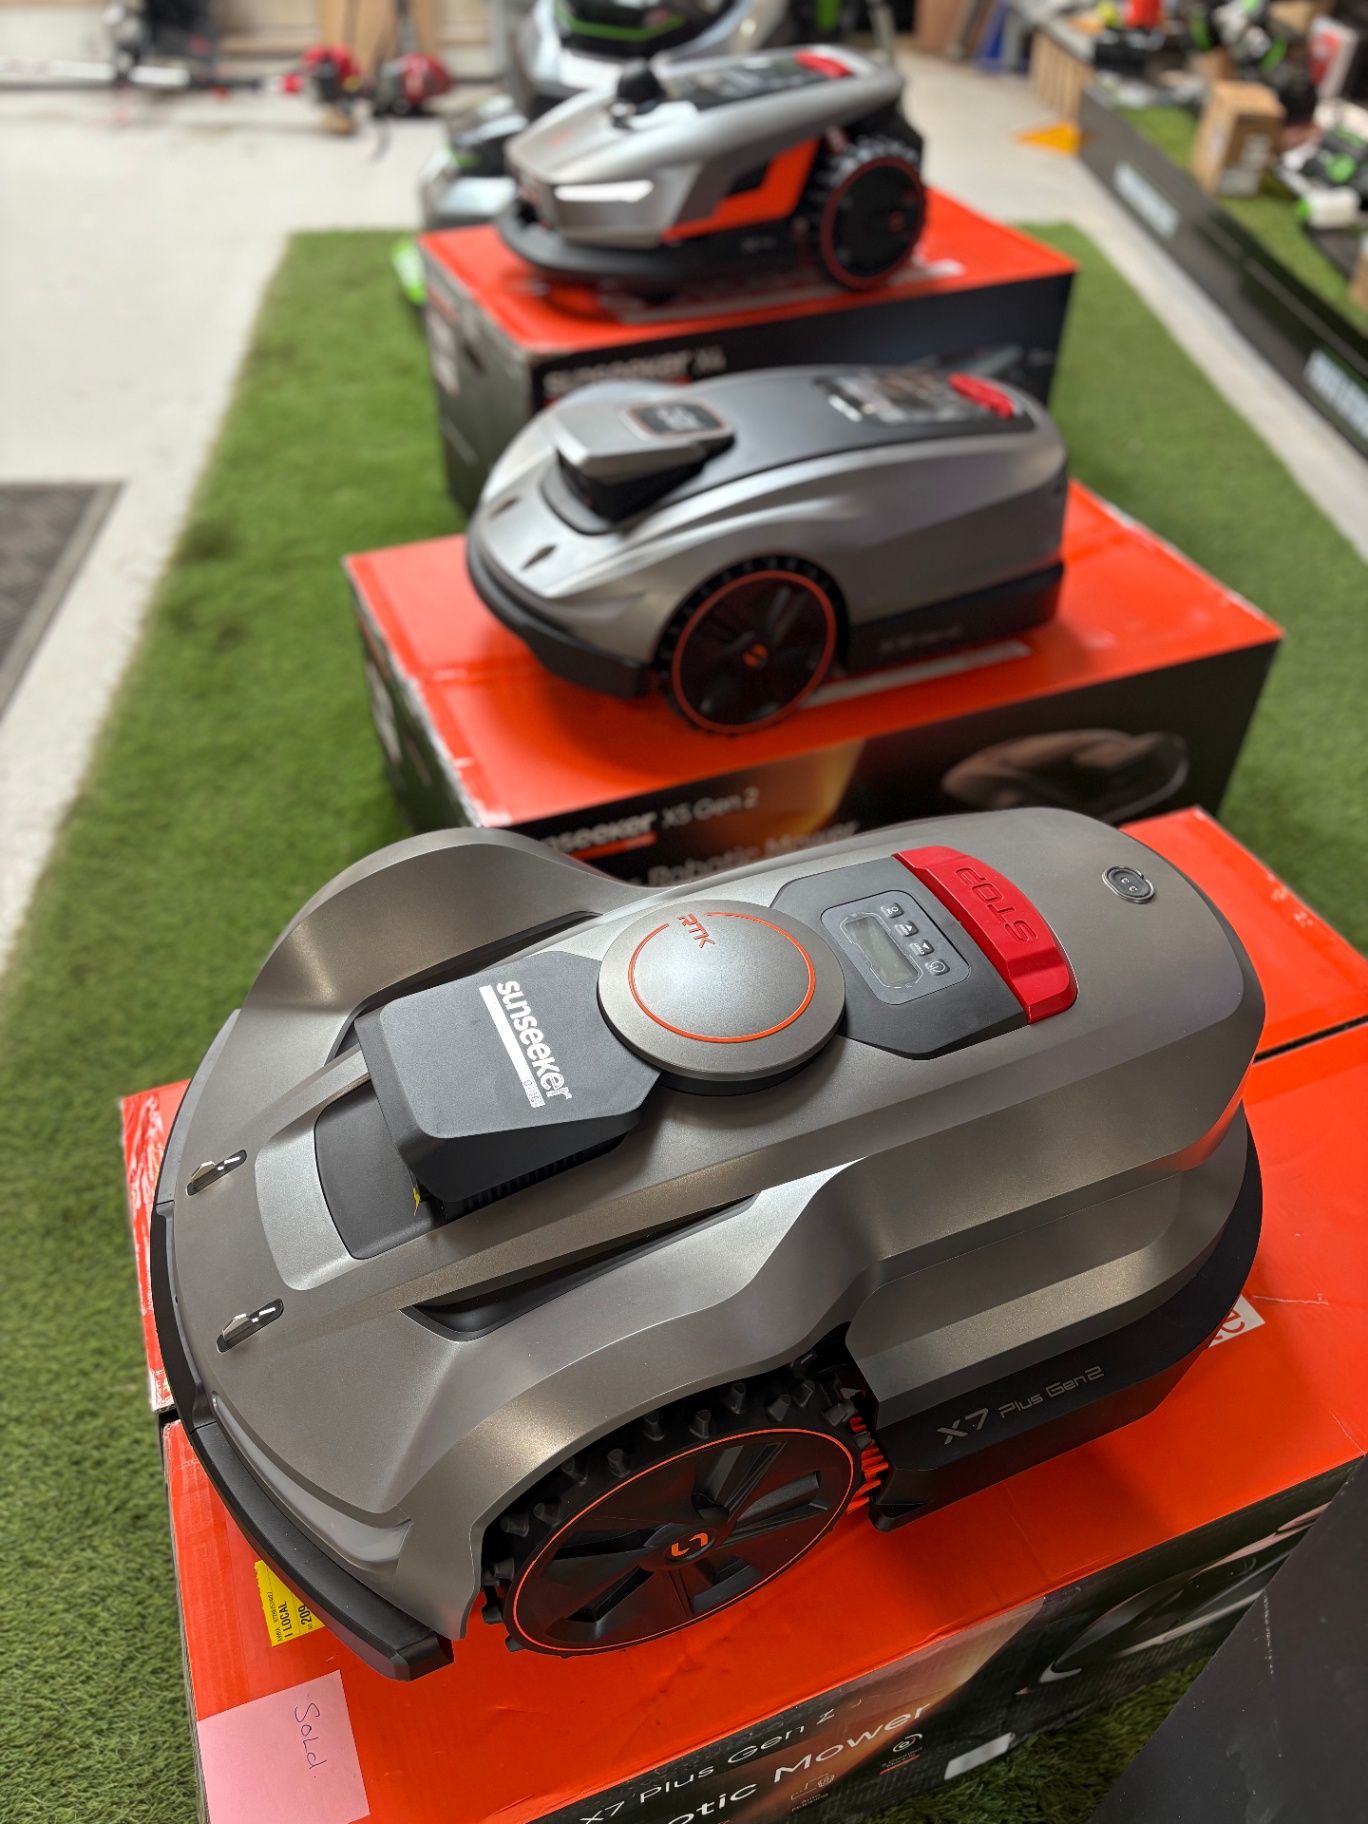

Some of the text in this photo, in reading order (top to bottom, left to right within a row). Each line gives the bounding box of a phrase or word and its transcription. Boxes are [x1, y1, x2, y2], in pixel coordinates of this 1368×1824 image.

[540, 812, 657, 852] nseeker
[955, 867, 1038, 942] STOP
[677, 913, 715, 948] RTK
[497, 981, 573, 1099] sunseeker
[937, 1407, 989, 1446] X7
[998, 1393, 1044, 1419] Plus
[277, 1600, 293, 1632] LOCAL
[773, 1702, 931, 1784] Mower
[640, 1766, 714, 1803] Plus
